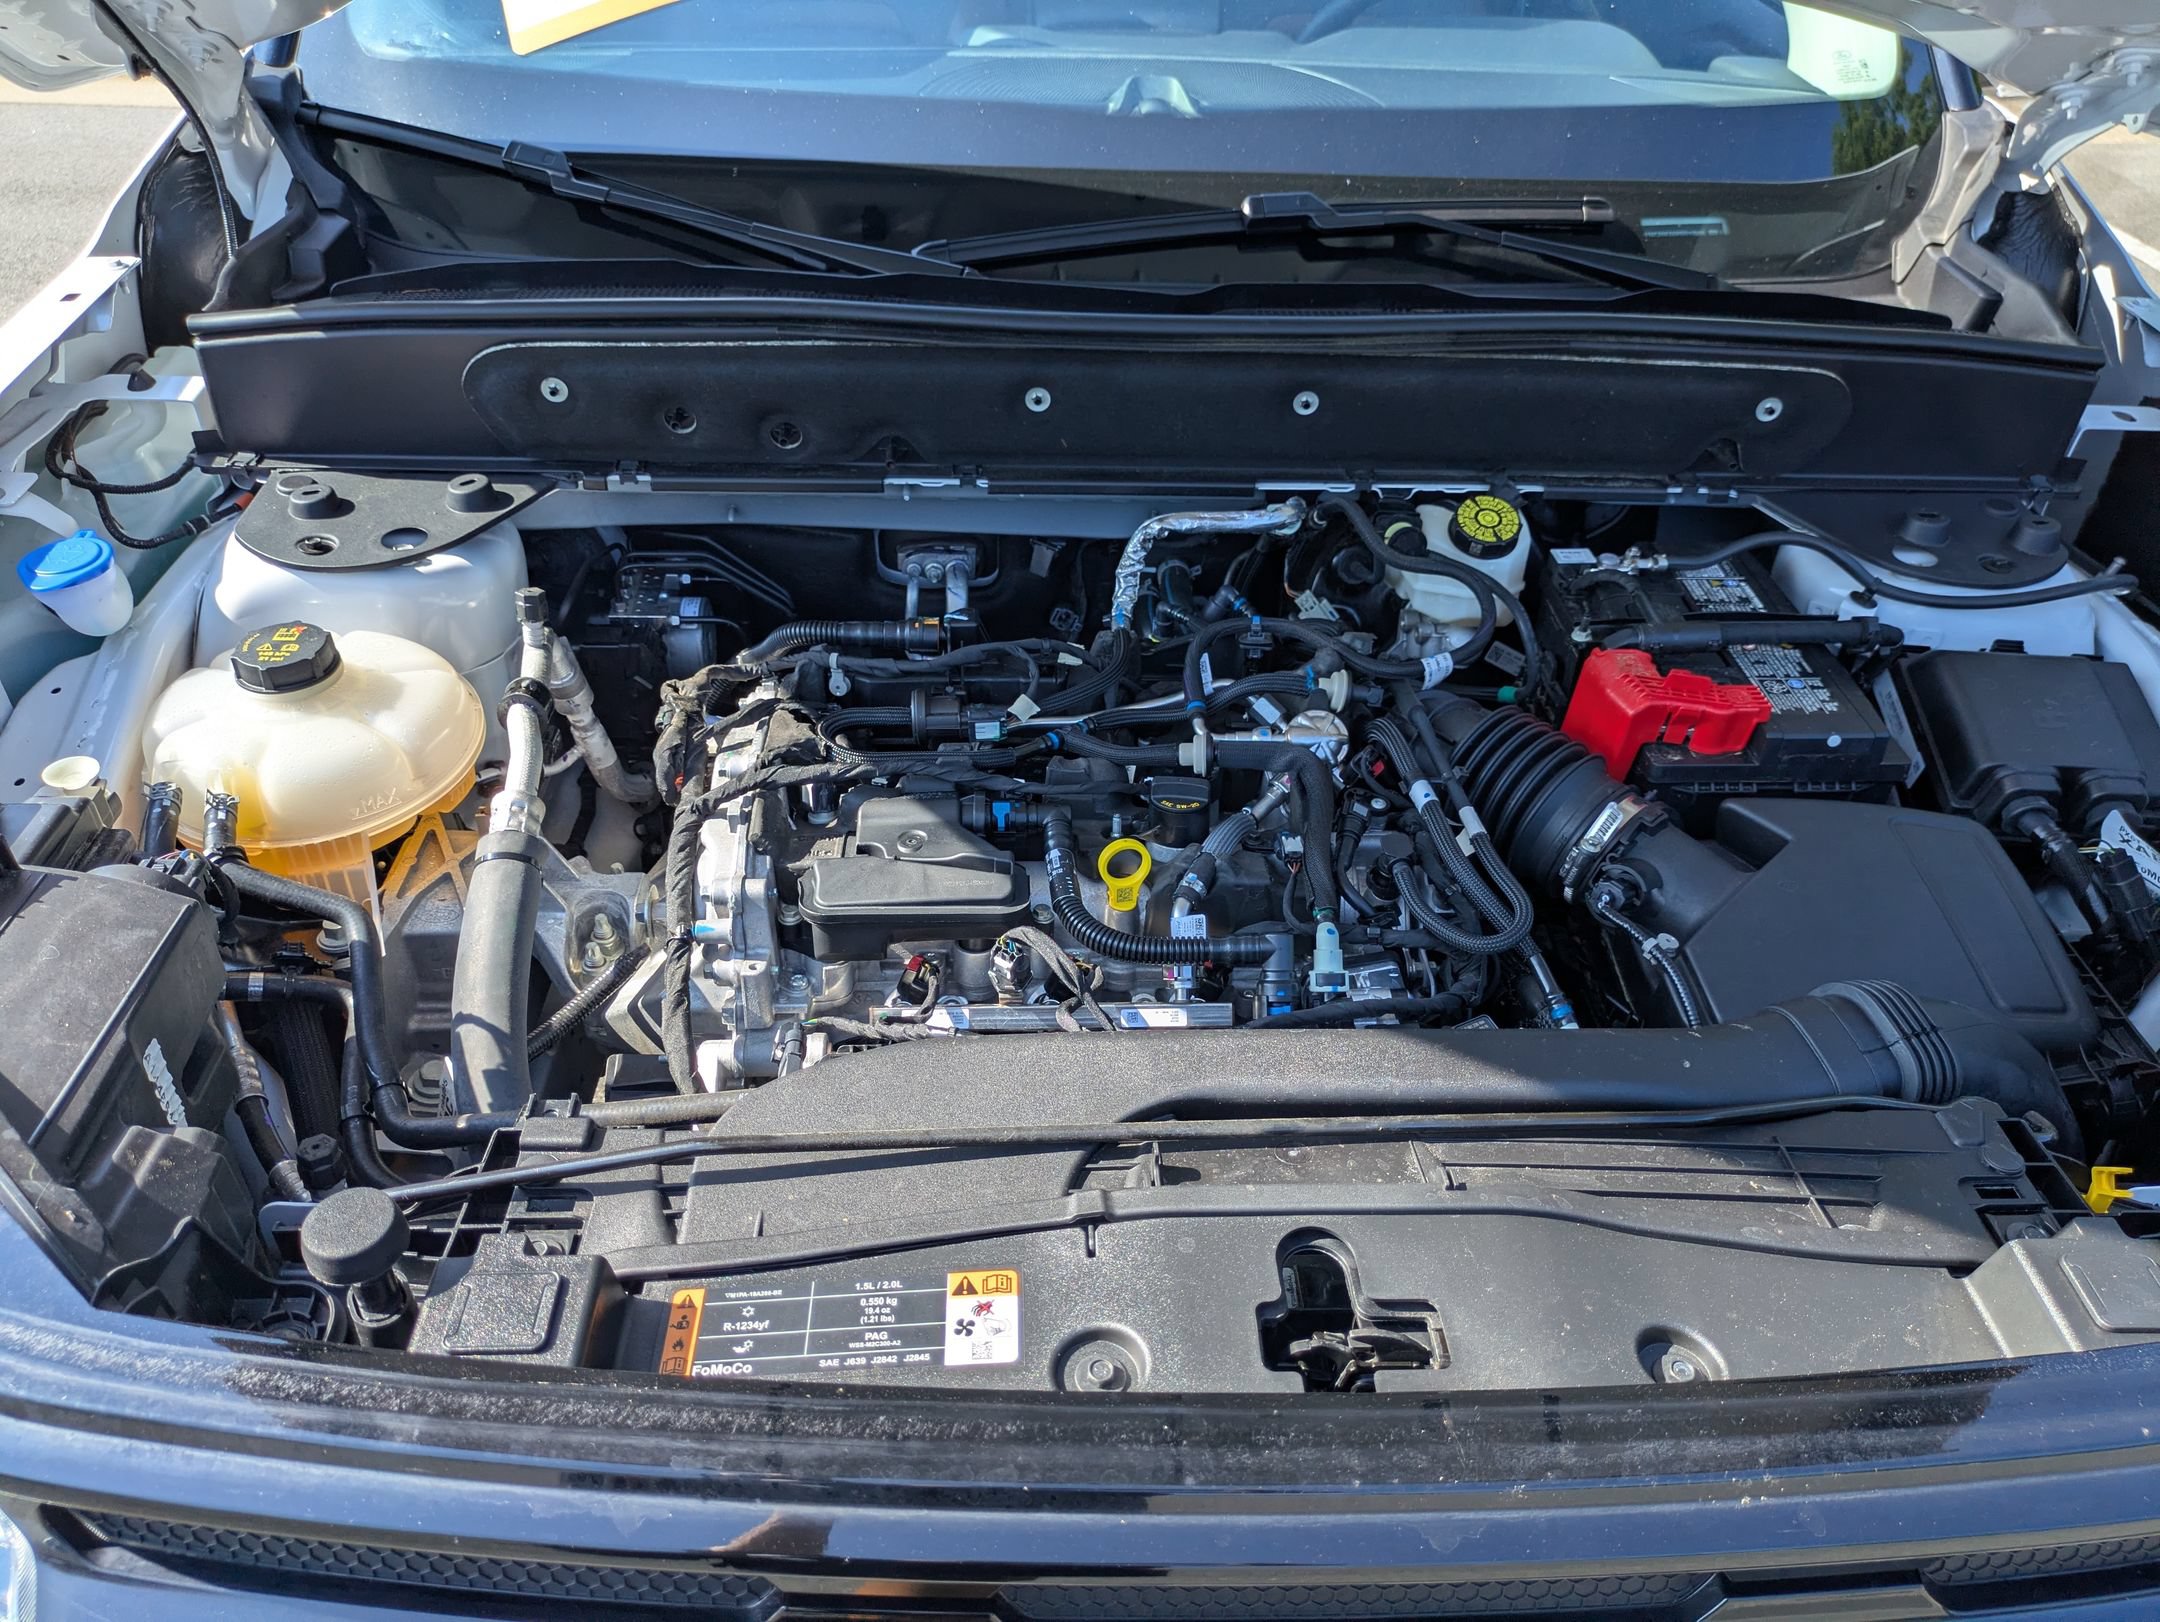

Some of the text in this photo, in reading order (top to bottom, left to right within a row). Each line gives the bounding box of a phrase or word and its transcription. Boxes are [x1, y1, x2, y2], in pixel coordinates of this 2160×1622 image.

[360, 787, 400, 813] MAX
[855, 1282, 875, 1290] 1.5L
[882, 1280, 903, 1289] 2.0L
[860, 1297, 898, 1306] 0.550 kg
[864, 1307, 880, 1315] 19.4
[860, 1314, 895, 1325] (1.21 lbs)
[723, 1320, 770, 1331] R-1234yf
[865, 1331, 888, 1340] PAG
[819, 1353, 930, 1367] SAE J639 J2842 J2845
[692, 1362, 752, 1376] FoMoCo
